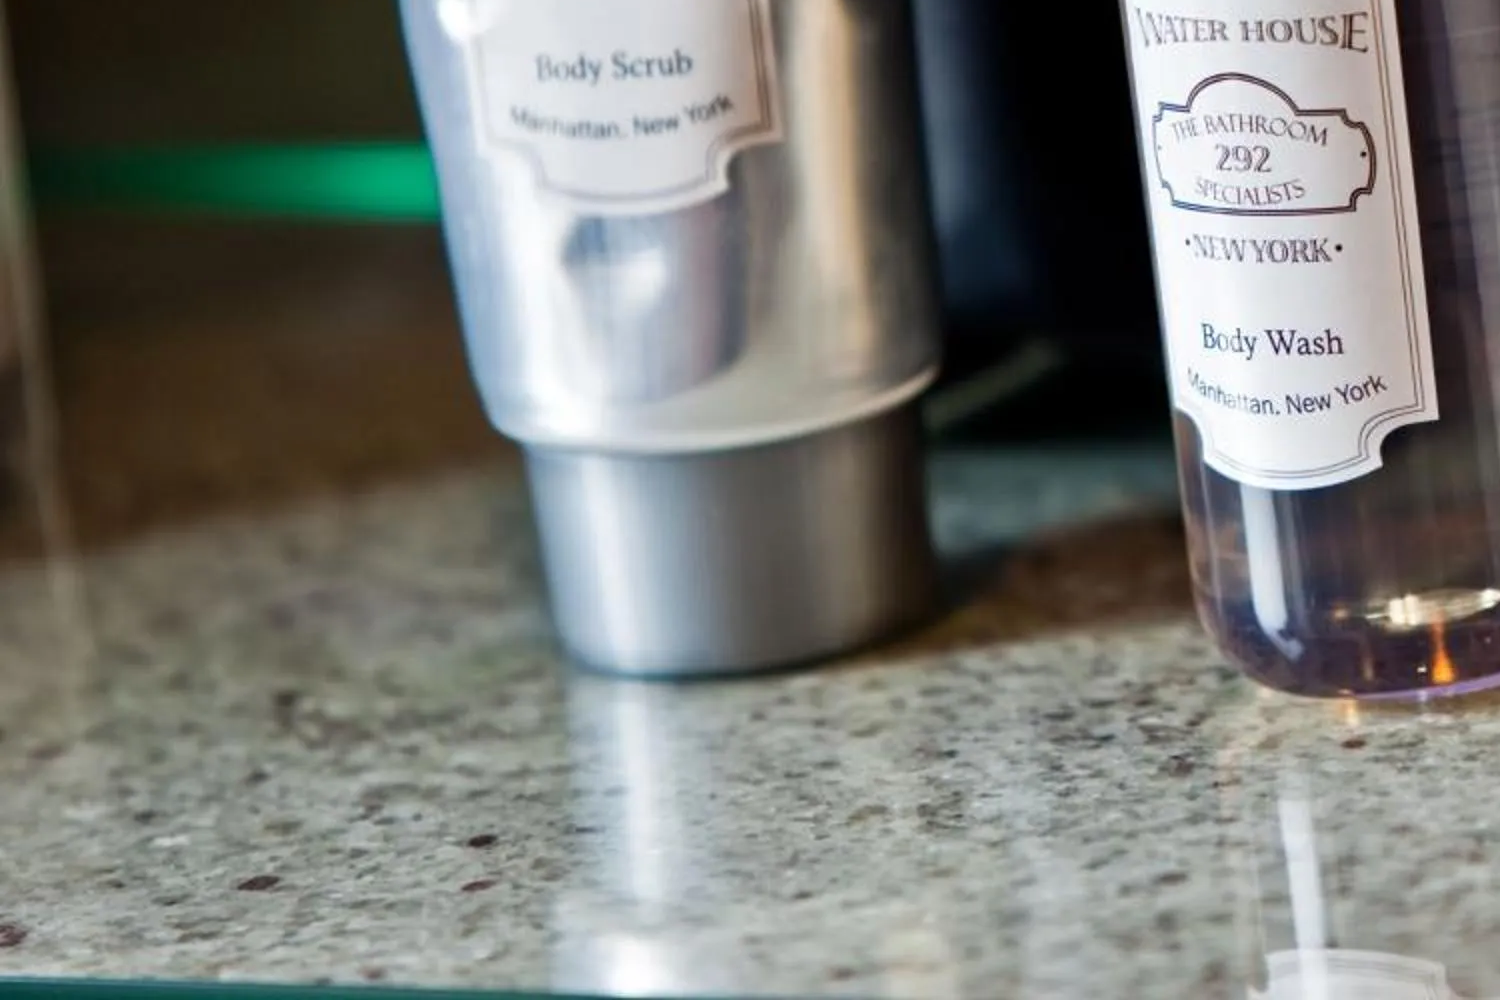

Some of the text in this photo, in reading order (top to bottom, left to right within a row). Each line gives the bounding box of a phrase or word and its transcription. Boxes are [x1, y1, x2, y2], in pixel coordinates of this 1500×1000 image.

[1134, 8, 1368, 53] WATER HOUSE
[536, 49, 694, 85] Body Scrub
[632, 113, 680, 137] New
[683, 94, 735, 124] York
[1171, 113, 1328, 147] THE BATHROOM
[1214, 144, 1272, 173] 292
[1195, 178, 1306, 206] SPECIALISTS
[1202, 323, 1344, 360] Body Wash
[1285, 393, 1331, 415] New
[1335, 375, 1389, 405] York
